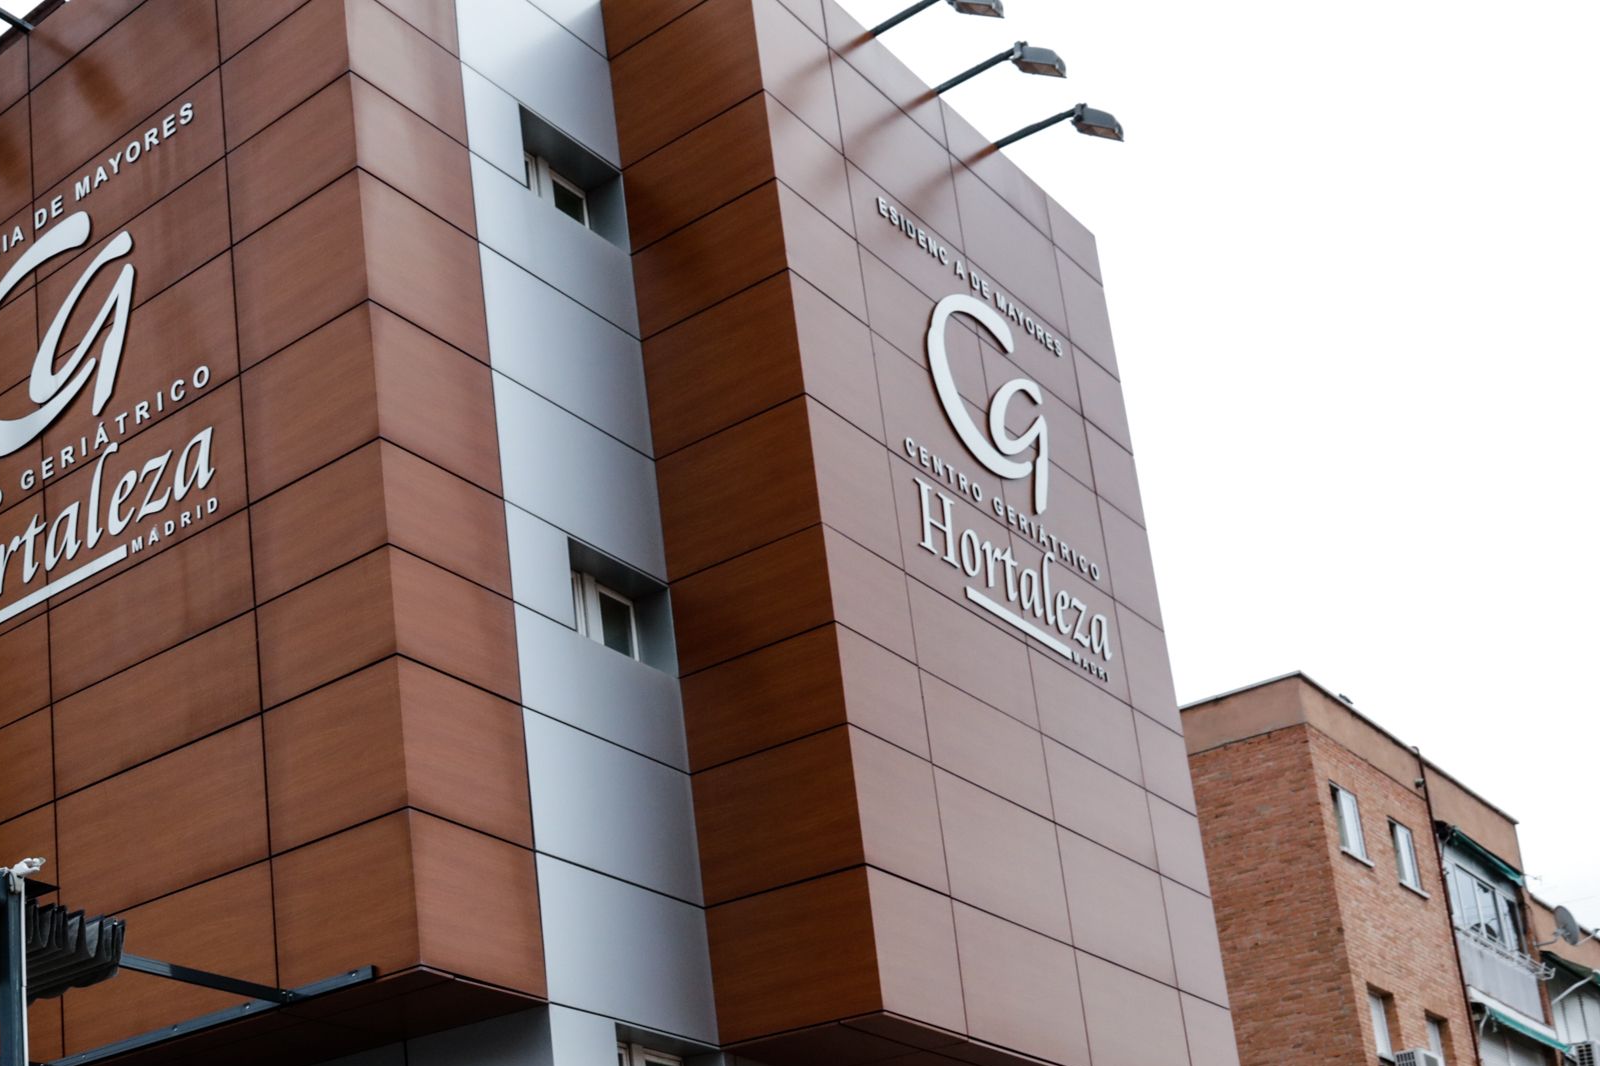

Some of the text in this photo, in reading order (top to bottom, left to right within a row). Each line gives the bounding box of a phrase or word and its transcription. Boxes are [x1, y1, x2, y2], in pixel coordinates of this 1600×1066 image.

[34, 194, 64, 230] DE
[74, 102, 194, 201] MAYORES
[969, 271, 991, 300] DE
[994, 291, 1063, 358] MAYORES
[20, 365, 211, 490] GERIÁTRICO
[131, 497, 220, 555] MADRID
[904, 437, 1100, 581] CENTRO GERIÁTRICO
[913, 477, 1113, 662] Hortaleza
